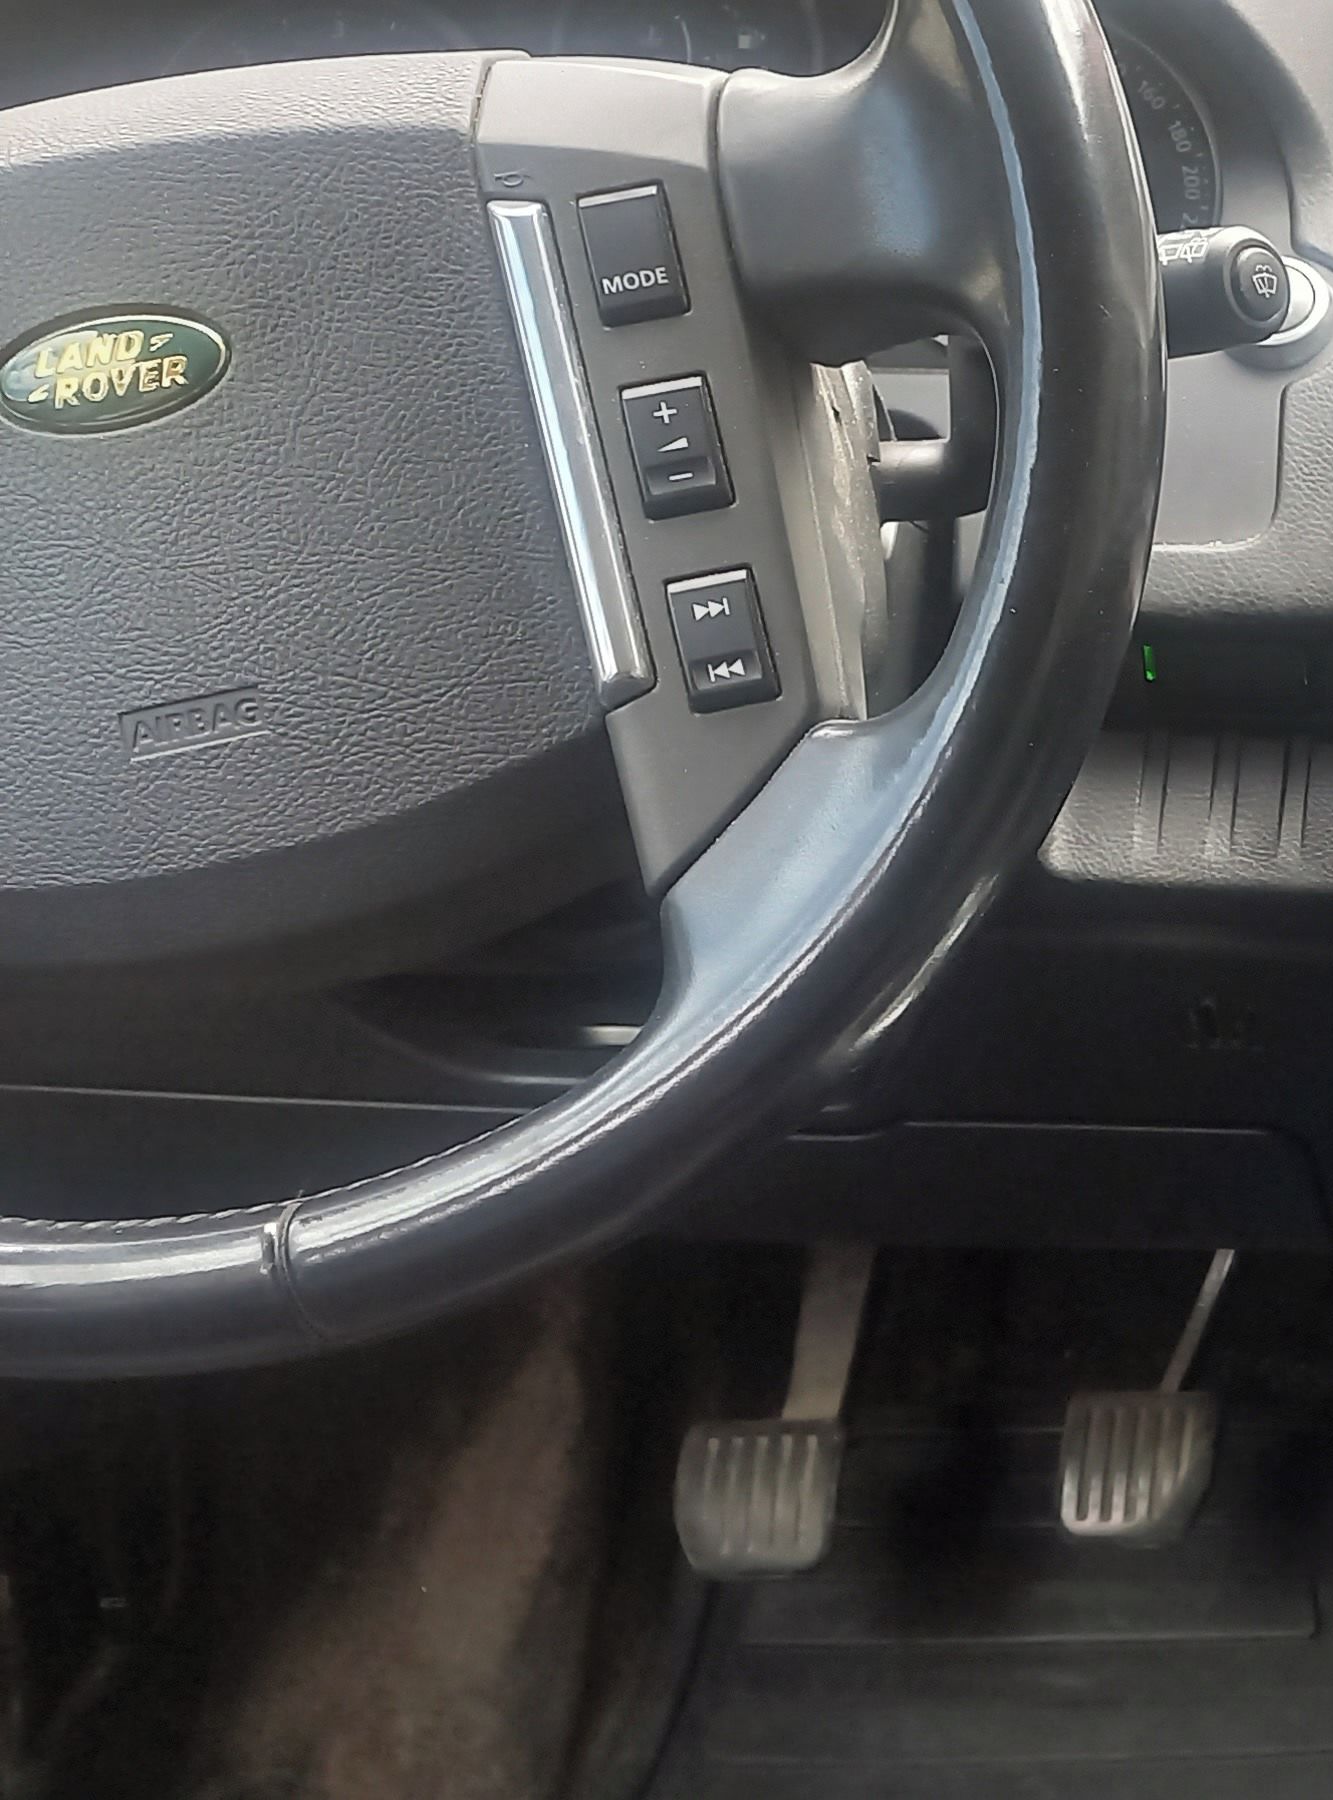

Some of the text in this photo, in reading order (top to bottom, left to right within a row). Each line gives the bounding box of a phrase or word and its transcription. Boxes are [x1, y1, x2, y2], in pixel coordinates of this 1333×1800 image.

[1181, 165, 1201, 200] 200
[602, 266, 669, 295] MODE
[34, 330, 145, 378] LAND
[54, 355, 189, 409] ROVER
[131, 697, 263, 753] AIRBAG
